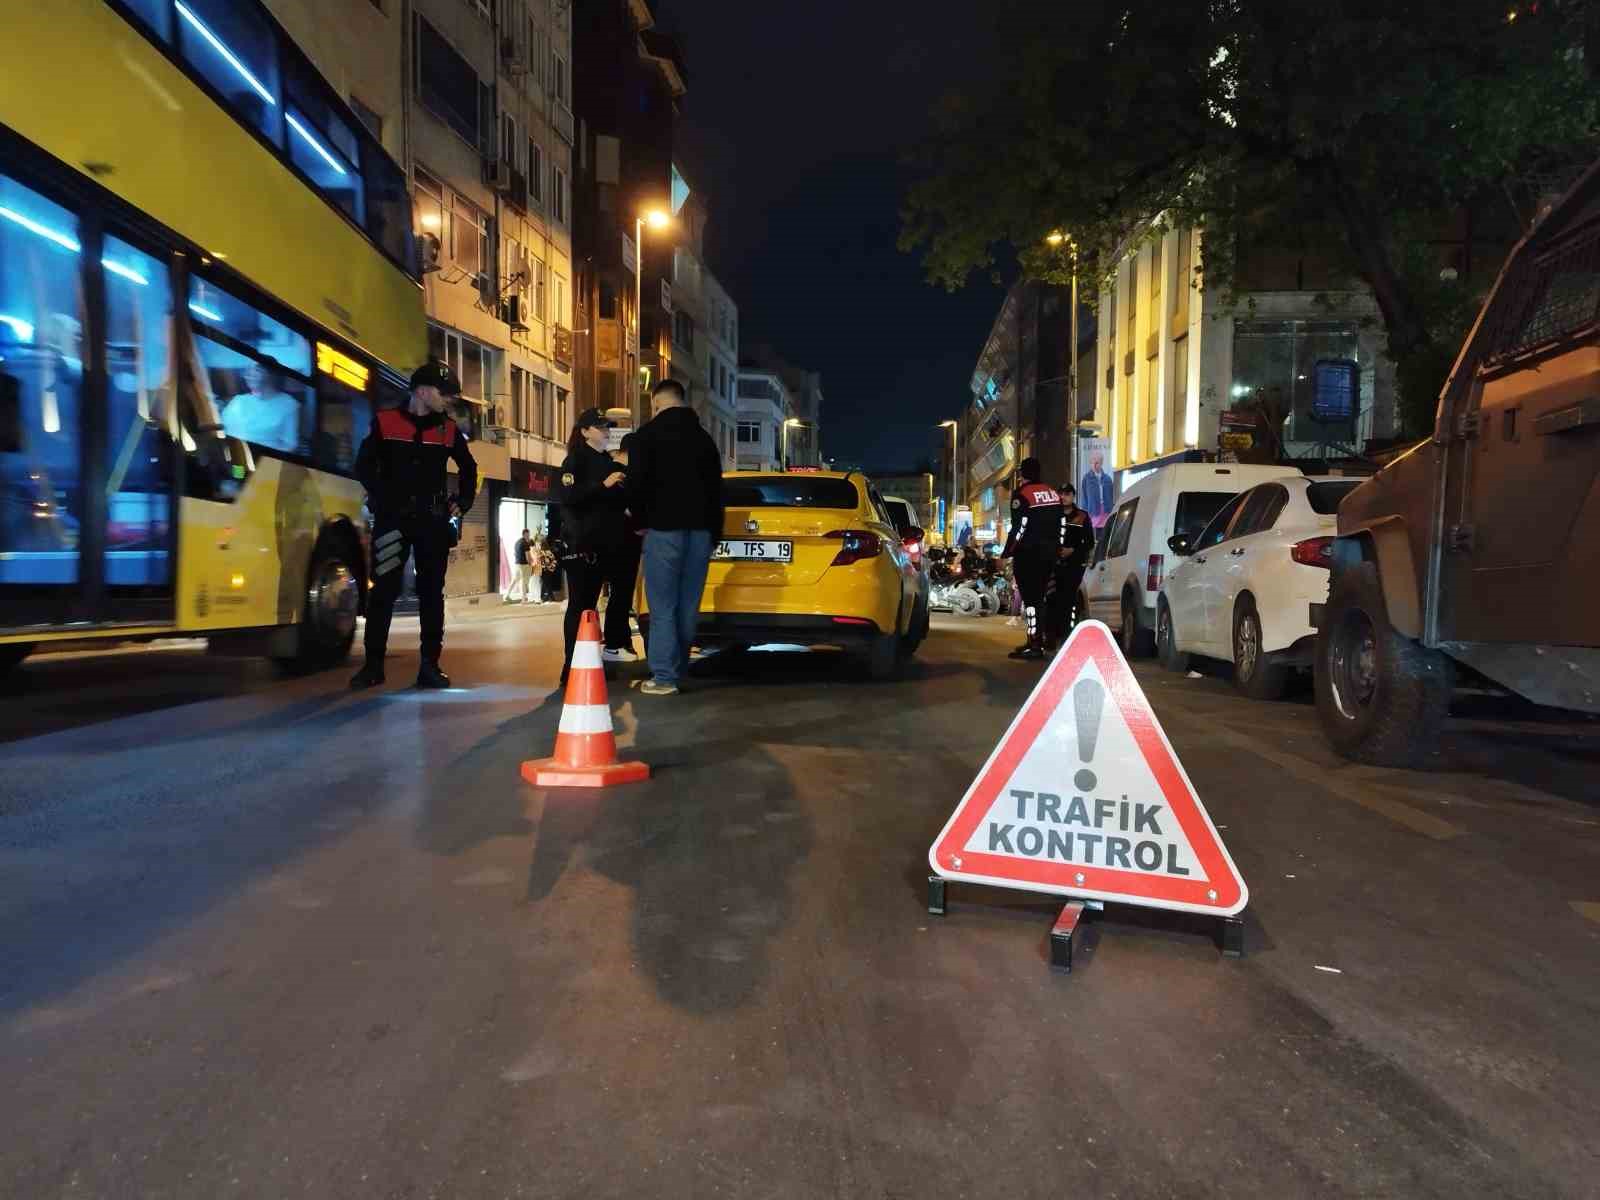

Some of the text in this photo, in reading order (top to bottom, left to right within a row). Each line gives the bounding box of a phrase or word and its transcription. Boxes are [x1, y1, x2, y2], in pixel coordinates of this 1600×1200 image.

[716, 542, 790, 557] 34 TFS 19
[1010, 789, 1163, 835] TRAFİK
[989, 822, 1190, 876] KONTROL
